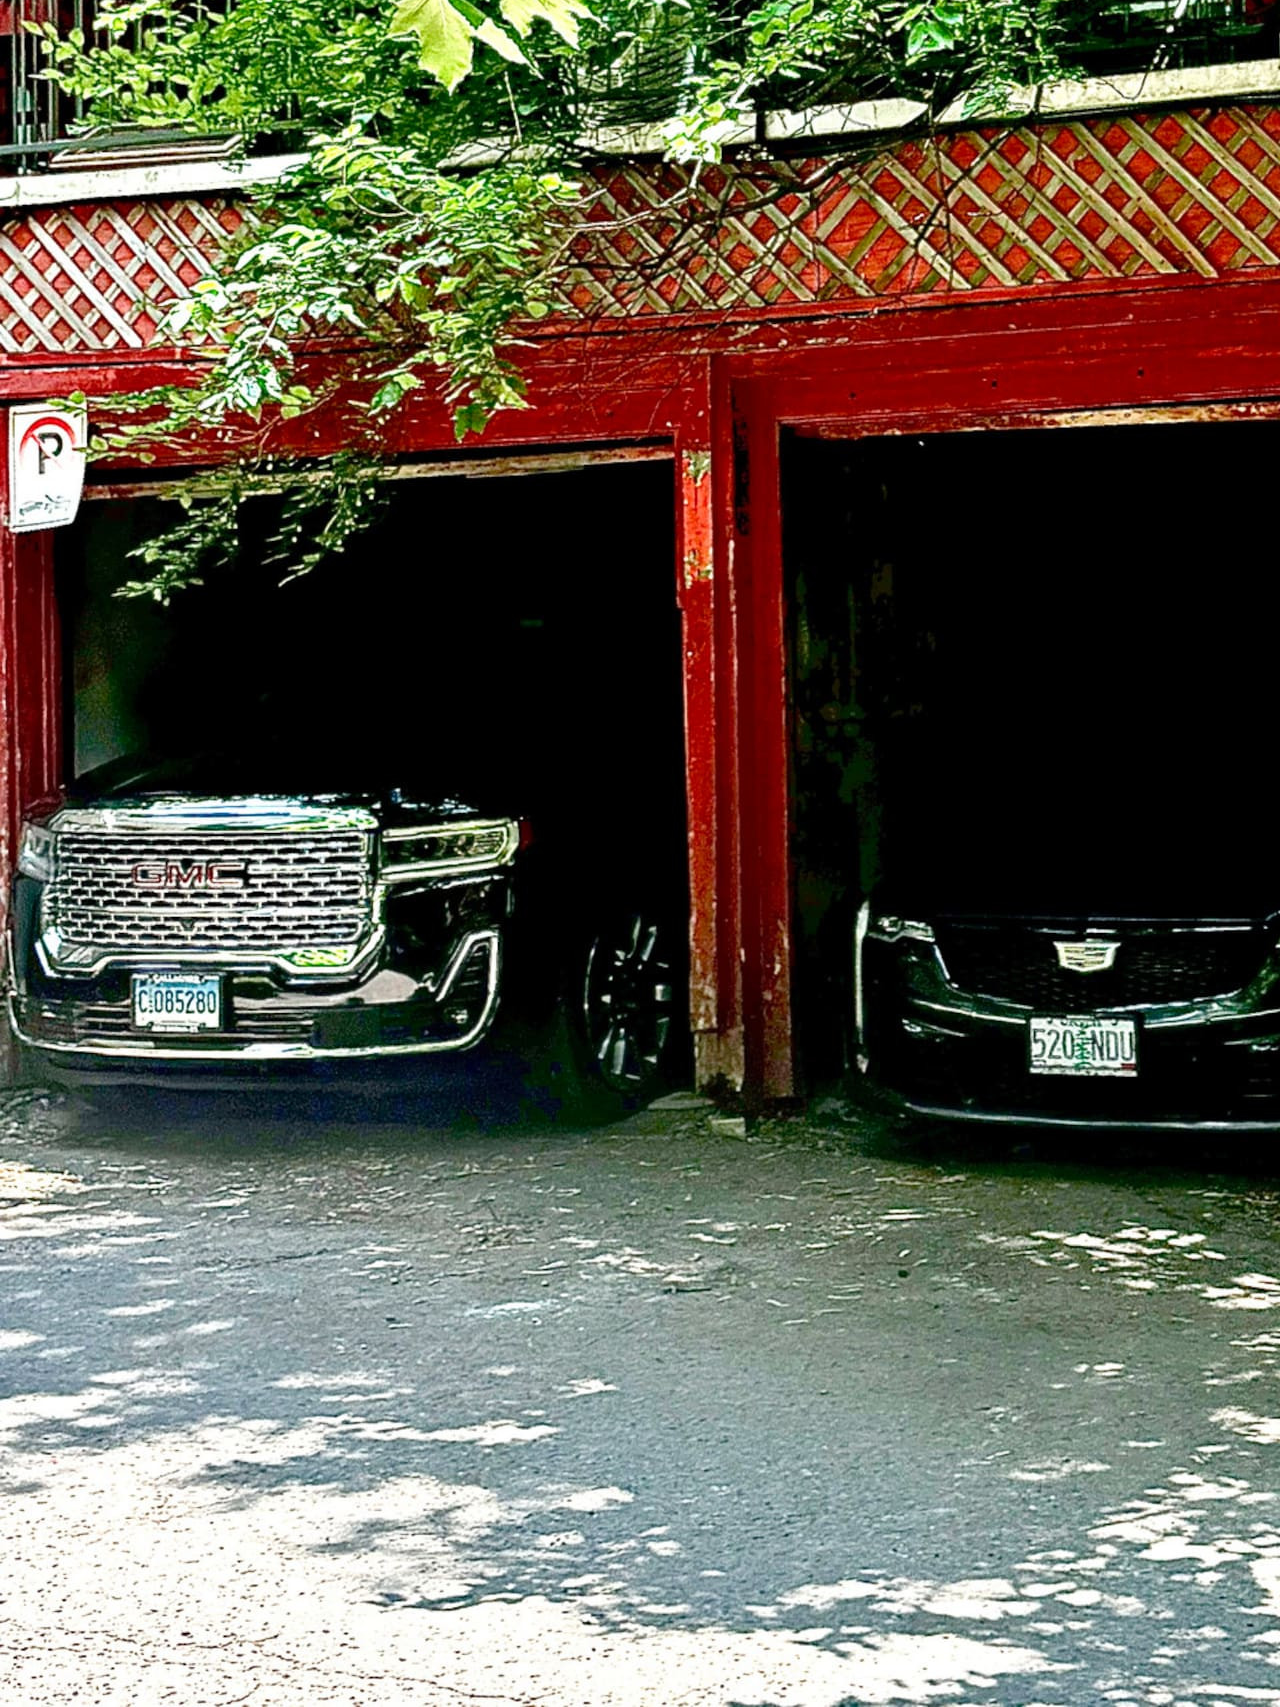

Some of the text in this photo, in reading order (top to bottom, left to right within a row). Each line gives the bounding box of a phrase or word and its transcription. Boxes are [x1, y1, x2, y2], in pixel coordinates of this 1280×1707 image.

[38, 432, 63, 475] P
[131, 862, 246, 889] GMC
[1032, 1028, 1075, 1060] 520
